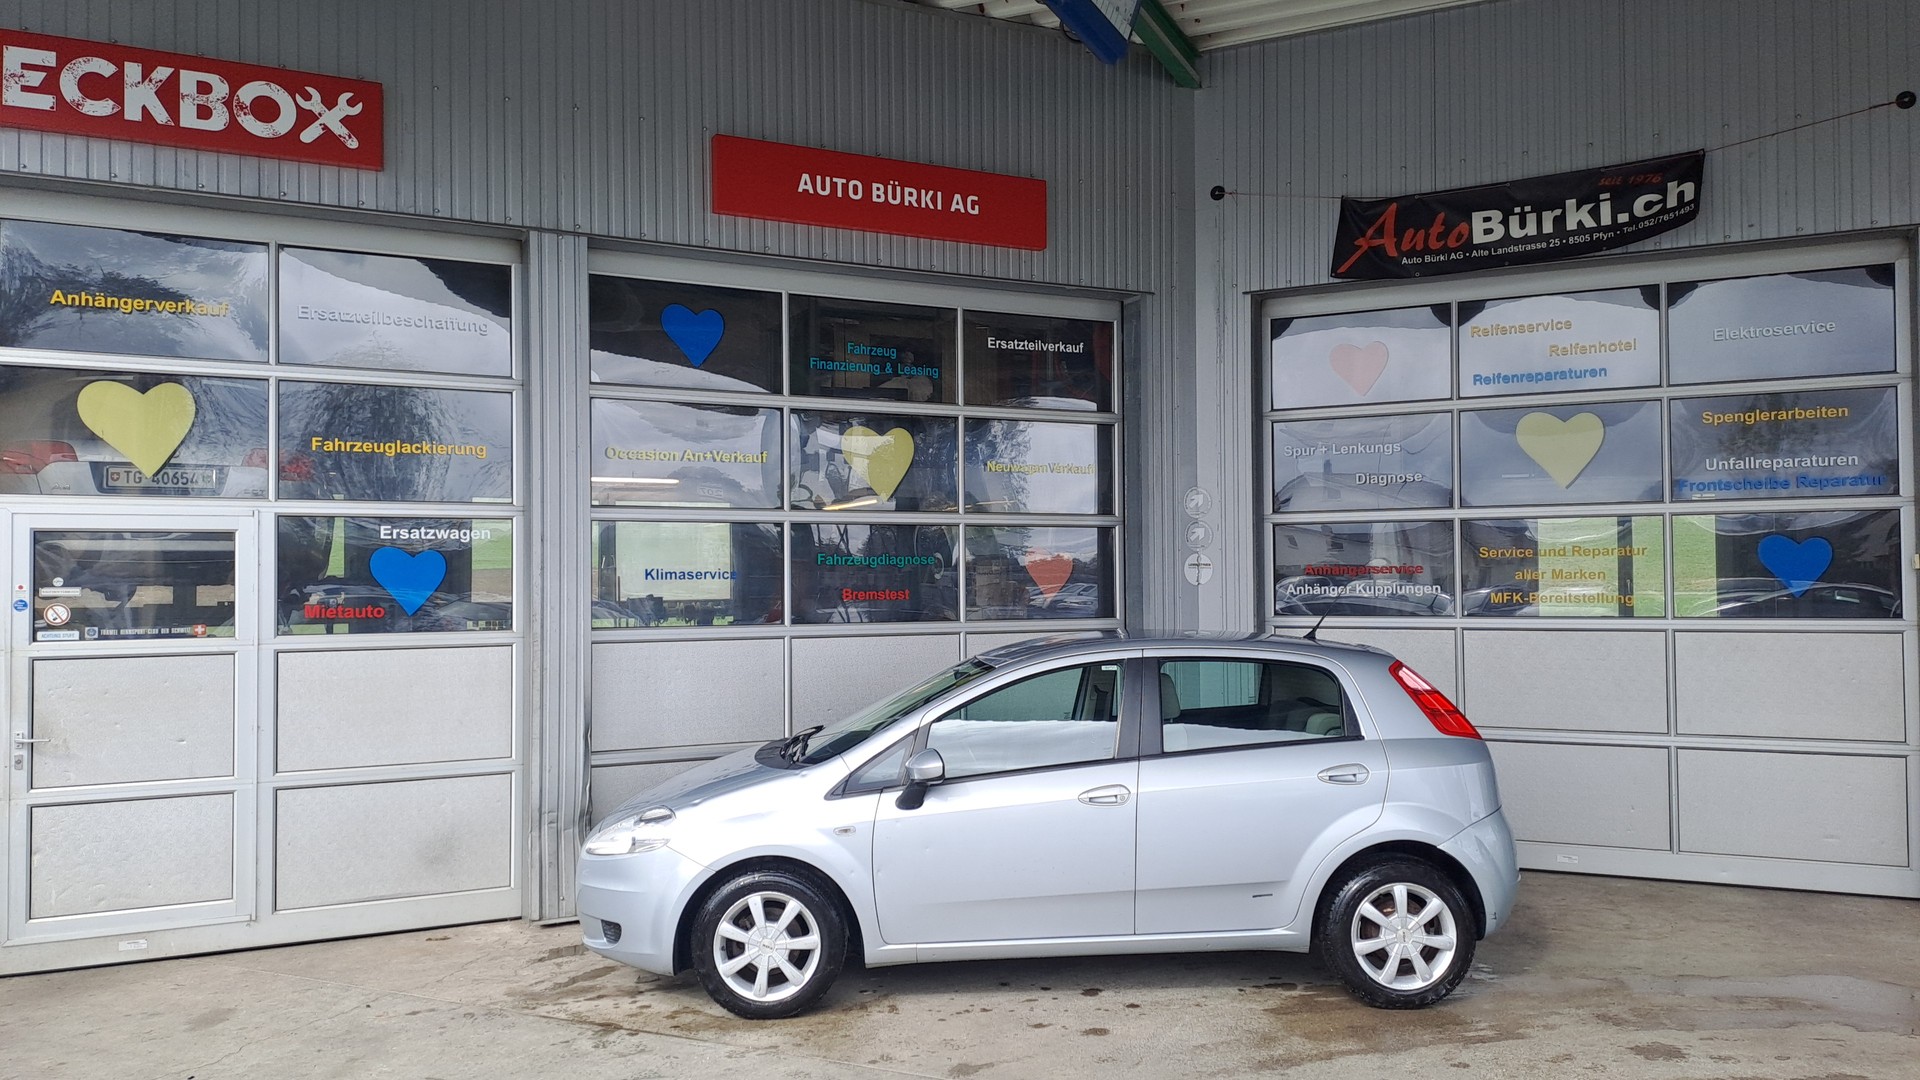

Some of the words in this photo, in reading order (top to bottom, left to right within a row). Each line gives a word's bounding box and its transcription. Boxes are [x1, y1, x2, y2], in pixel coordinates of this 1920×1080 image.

[1598, 175, 1623, 186] seit
[1629, 172, 1663, 184] 1976
[797, 173, 864, 200] AUTO
[872, 180, 943, 211] BÜRKI
[950, 193, 980, 215] AG
[1401, 256, 1423, 265] Auto
[1424, 254, 1448, 263] Bürki
[1450, 252, 1464, 261] AG
[1471, 250, 1489, 258] Alte
[1491, 242, 1547, 256] Landstrasse
[1549, 239, 1561, 248] 25
[1568, 235, 1591, 246] 8505
[1593, 231, 1615, 243] Pfyn
[49, 288, 230, 318] Anhängerverkauf
[297, 304, 489, 337] Ersatzteilbeschaffung
[1470, 319, 1573, 338] Reifenservice
[1713, 320, 1837, 343] Elektroservice
[847, 342, 897, 360] Fahrzeug
[987, 337, 1084, 354] Ersatzteilverkauf
[1549, 338, 1638, 358] Reifenhotel
[809, 357, 881, 375] Finanzierung
[884, 364, 893, 374] &
[897, 362, 939, 379] Leasing
[1472, 367, 1608, 386] Reifenreparaturen
[1702, 406, 1850, 426] Spenglerarbeiten
[311, 436, 488, 459] Fahrzeuglackierung
[605, 446, 680, 462] Occasion
[682, 448, 768, 464] An+Verkauf
[1283, 445, 1316, 459] Spur
[1319, 446, 1328, 455] +
[1332, 442, 1402, 456] Lenkungs
[1705, 454, 1860, 472] Unfallreparaturen
[123, 470, 142, 484] TG
[1355, 472, 1424, 487] Diagnose
[1678, 476, 1791, 492] Frontscheibe
[1796, 472, 1888, 490] Reparatur
[379, 525, 492, 543] Ersatzwagen
[1479, 546, 1534, 558] Service
[1540, 545, 1567, 557] und
[1571, 544, 1648, 559] Reparatur
[817, 553, 936, 569] Fahrzeugdiagnose
[644, 567, 737, 581] Klimaservice
[1304, 563, 1424, 578] Anhängerservice
[1514, 568, 1547, 580] aller
[1551, 568, 1607, 580] Marken
[842, 588, 910, 601] Bremstest
[1287, 583, 1352, 597] Anhänger
[1355, 582, 1442, 598] Kupplungen
[1490, 592, 1635, 607] MFK-Bereitstellung
[304, 603, 386, 619] Mietauto
